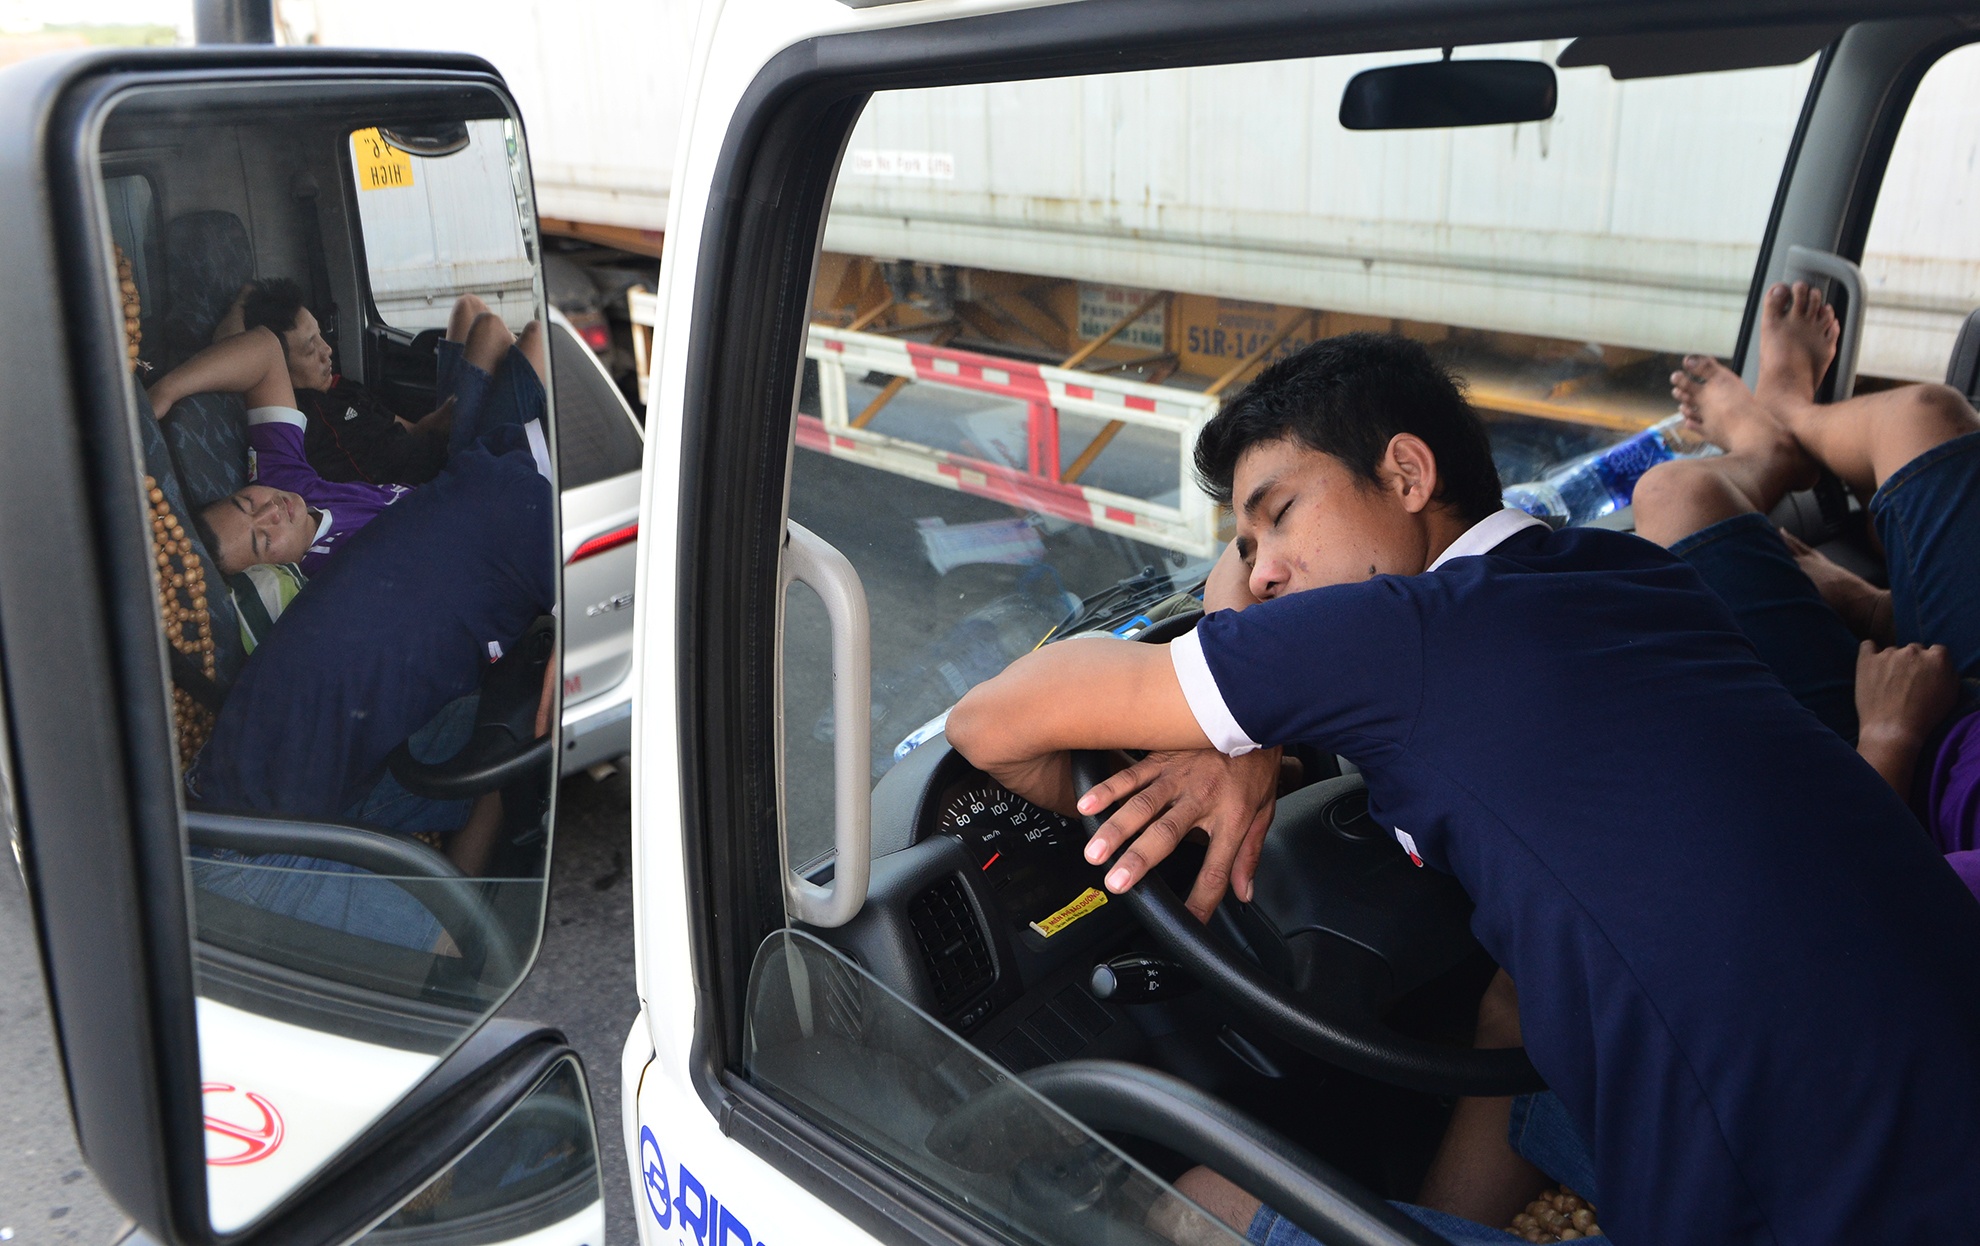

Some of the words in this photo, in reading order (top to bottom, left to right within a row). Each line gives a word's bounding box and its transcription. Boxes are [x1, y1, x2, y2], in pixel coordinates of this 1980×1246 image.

[970, 801, 986, 814] 80
[990, 802, 1009, 816] 100
[956, 813, 971, 827] 60
[1009, 812, 1028, 826] 120
[981, 829, 1001, 842] km/h
[1024, 828, 1042, 842] 140
